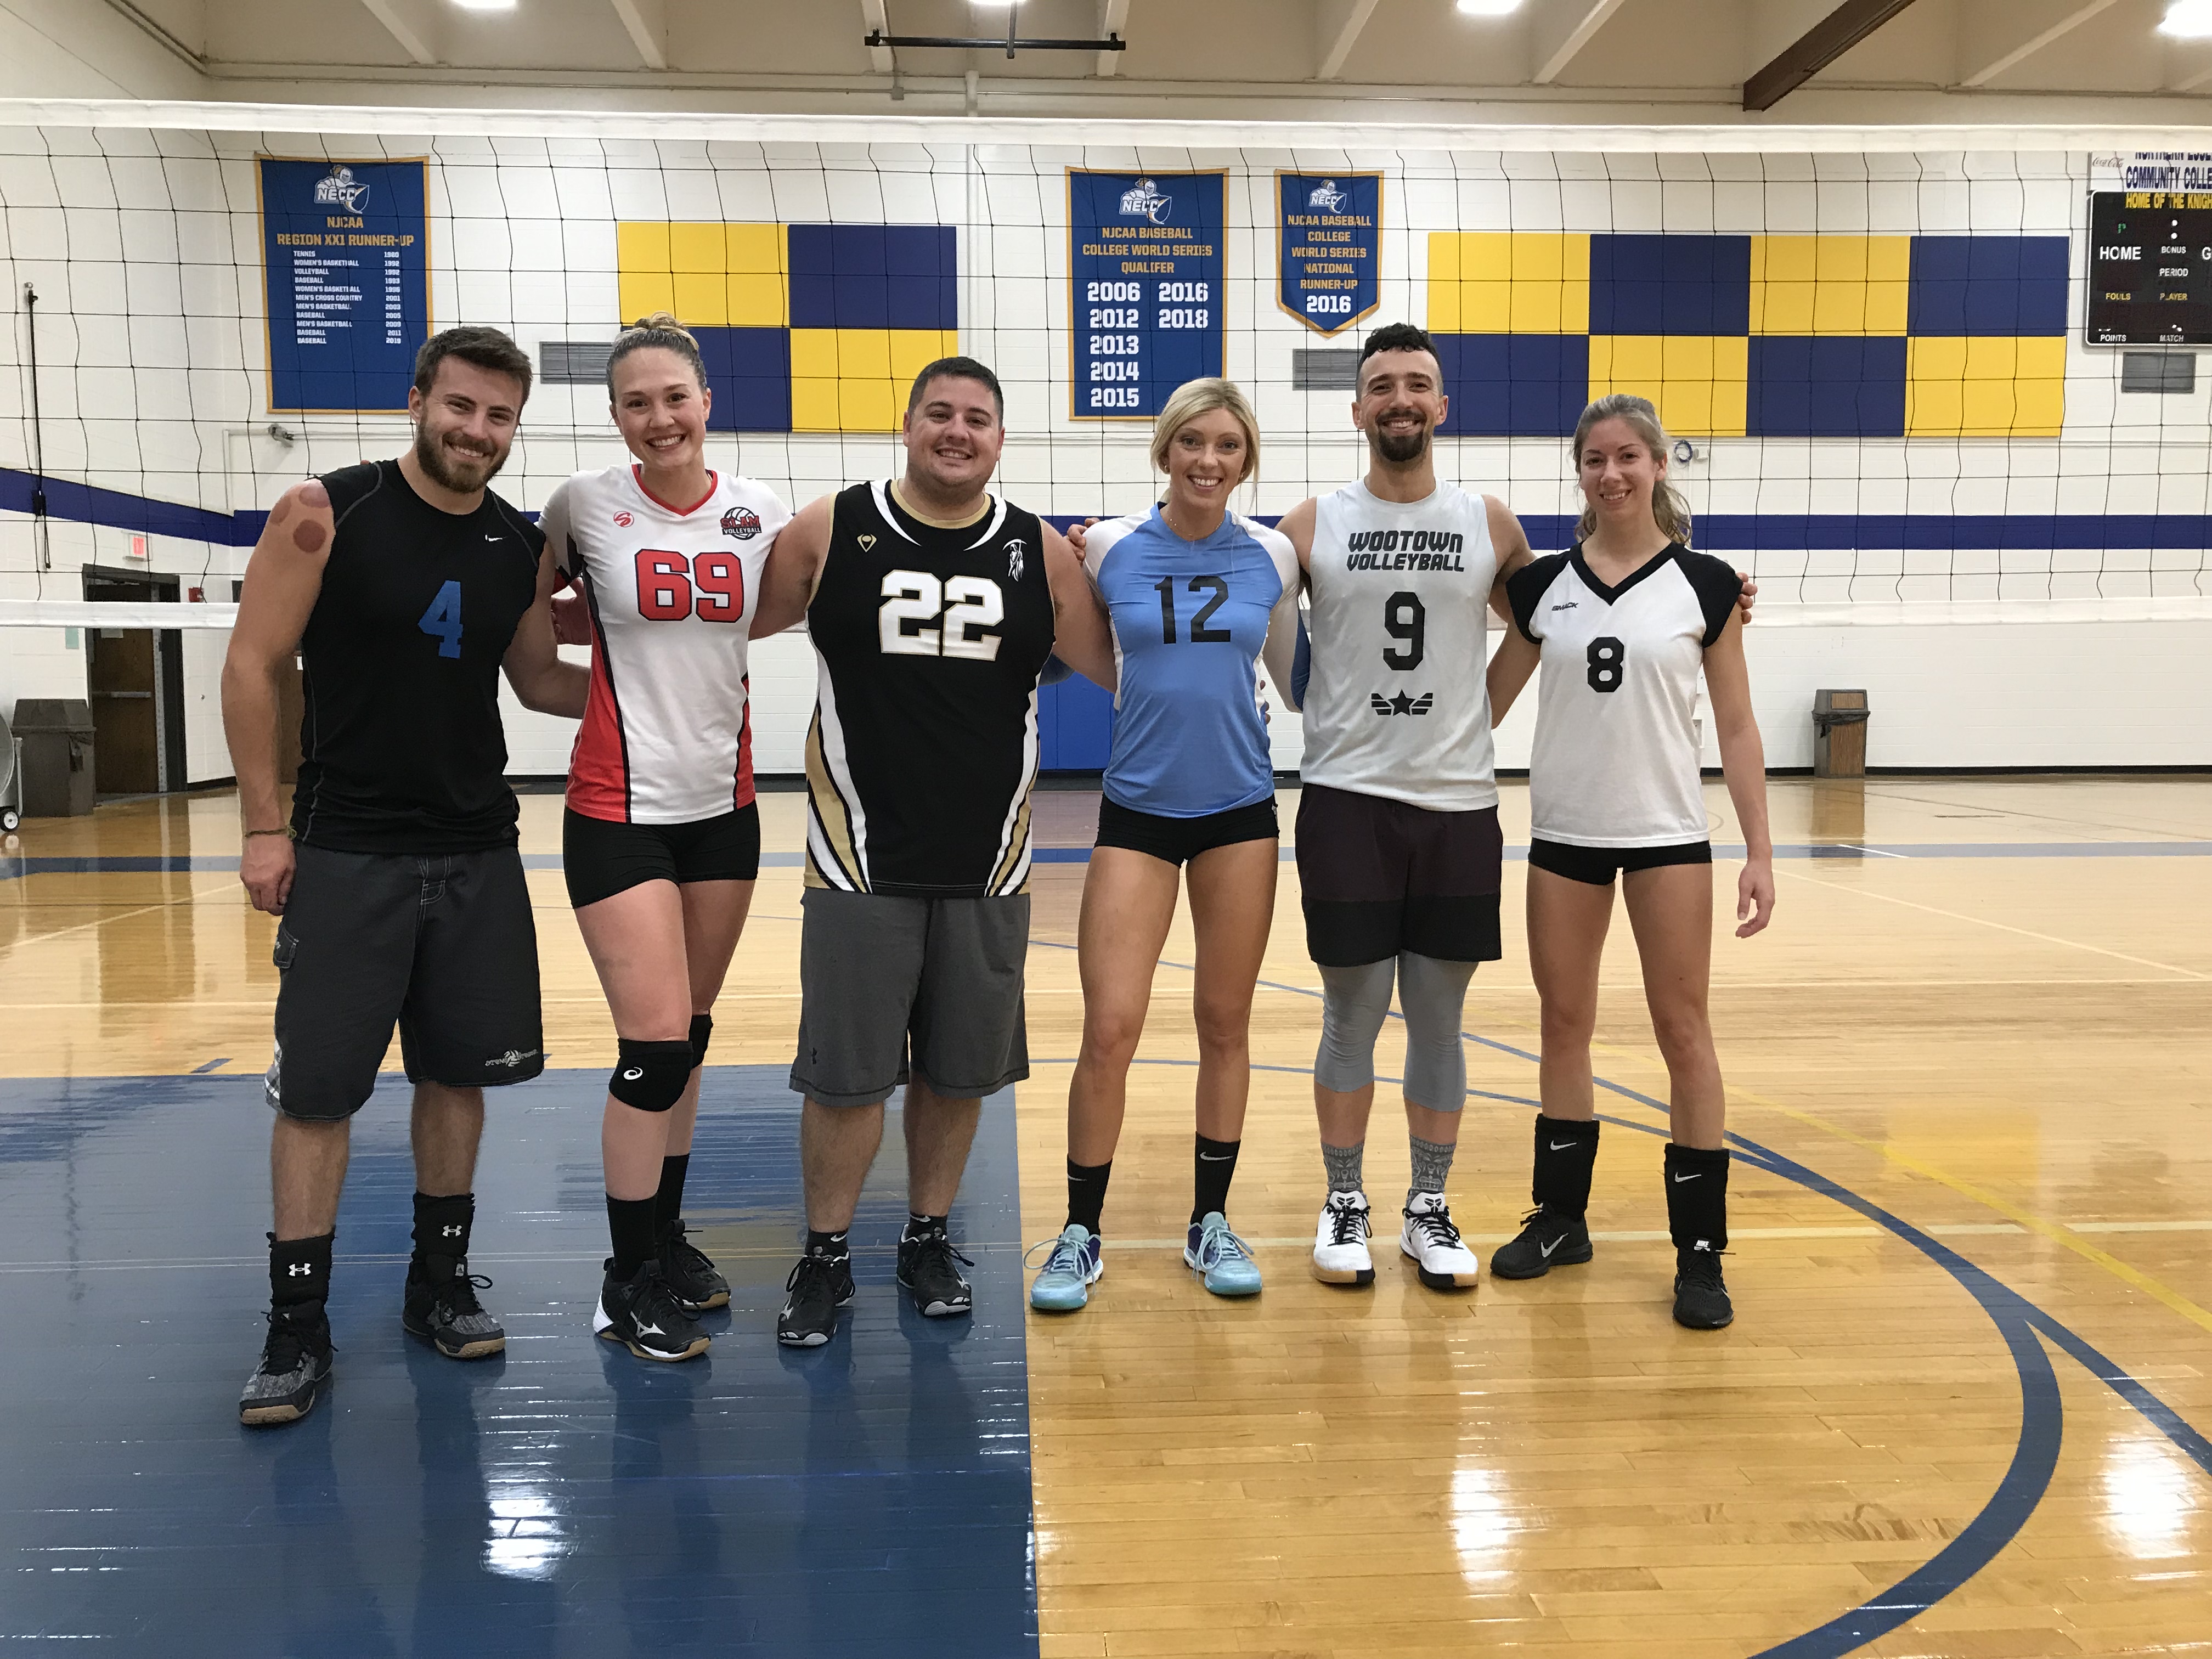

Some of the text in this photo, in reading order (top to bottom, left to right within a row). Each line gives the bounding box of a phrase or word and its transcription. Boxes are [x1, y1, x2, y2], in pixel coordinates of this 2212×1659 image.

[2126, 166, 2181, 189] COMMUNITY
[317, 188, 356, 202] NECC
[1311, 194, 1338, 205] NECC
[2125, 193, 2151, 209] HOME
[2154, 193, 2165, 209] OF
[2168, 193, 2185, 209] THE
[1122, 199, 1159, 213] NECC
[326, 216, 364, 228] NJCAA
[1288, 215, 1372, 226] NJCAA BASEBALL
[276, 234, 322, 245] REGION
[348, 234, 414, 246] RUNNER-UP
[1102, 227, 1193, 239] NJCAA BASEBALL
[1307, 231, 1351, 242] COLLEGE
[1082, 244, 1212, 256] COLLEGE WORLD SERIES
[1291, 247, 1367, 258] WORLD SERIES
[2100, 246, 2141, 260] HOME
[2161, 246, 2186, 254] BONUS
[1121, 262, 1175, 274] QUALIFER
[1304, 263, 1355, 274] NATIONAL
[2159, 268, 2188, 277] PERIOD
[1300, 279, 1358, 290] RUNNER-UP
[1087, 282, 1209, 302] 2006 2016
[2106, 292, 2188, 301] FOULS PAYER
[1306, 295, 1351, 313] 2016
[1090, 308, 1208, 329] 2012 2018
[1090, 335, 1139, 354] 2013
[2100, 334, 2184, 342] POINTS MATCH
[1090, 362, 1139, 381] 2014
[1091, 388, 1139, 407] 2015
[720, 515, 760, 529] SLAM
[1348, 530, 1463, 553] WOOTOWN
[1346, 552, 1464, 572] VOLLEYBALL
[634, 549, 744, 623] 69
[879, 569, 1004, 662] 22
[1154, 575, 1231, 644] 12
[417, 580, 463, 658] 4
[1383, 591, 1425, 670] 9
[1587, 636, 1624, 692] 8
